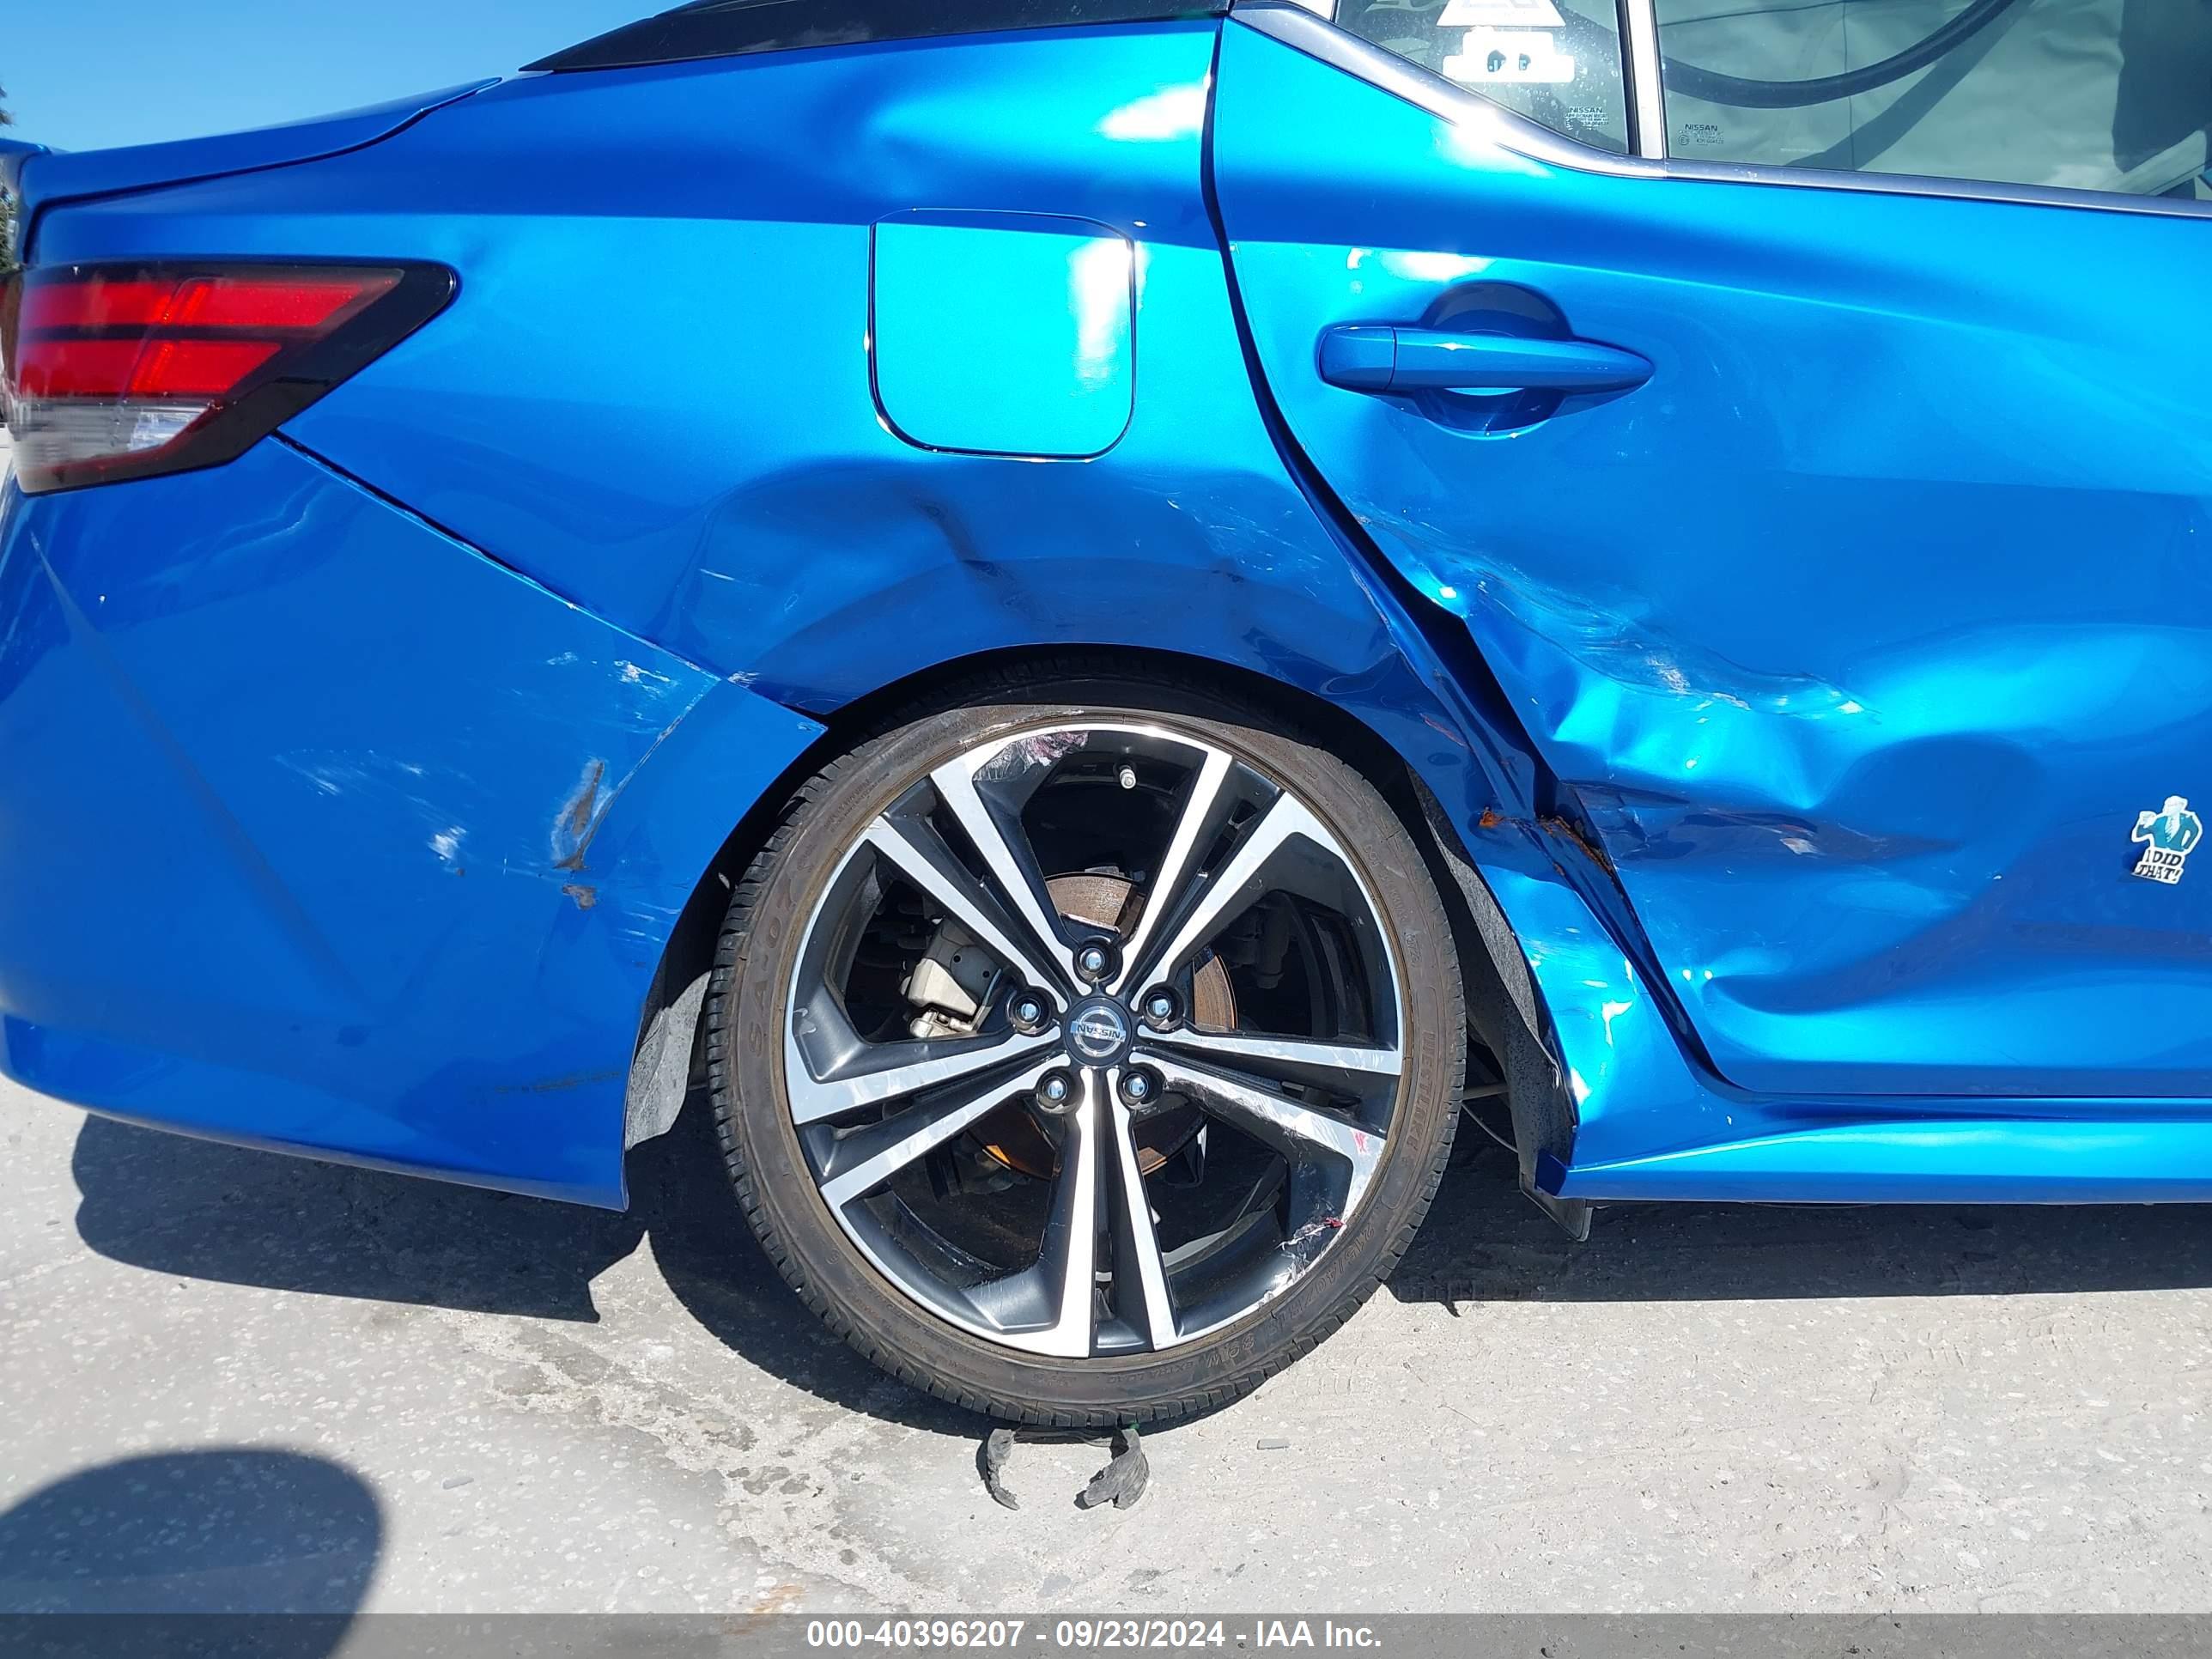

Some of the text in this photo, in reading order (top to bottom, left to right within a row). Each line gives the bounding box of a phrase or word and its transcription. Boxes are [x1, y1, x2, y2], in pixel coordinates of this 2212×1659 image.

[2146, 849, 2182, 866] I DID
[2136, 865, 2180, 881] THAT!
[1076, 1023, 1121, 1039] NISSAN
